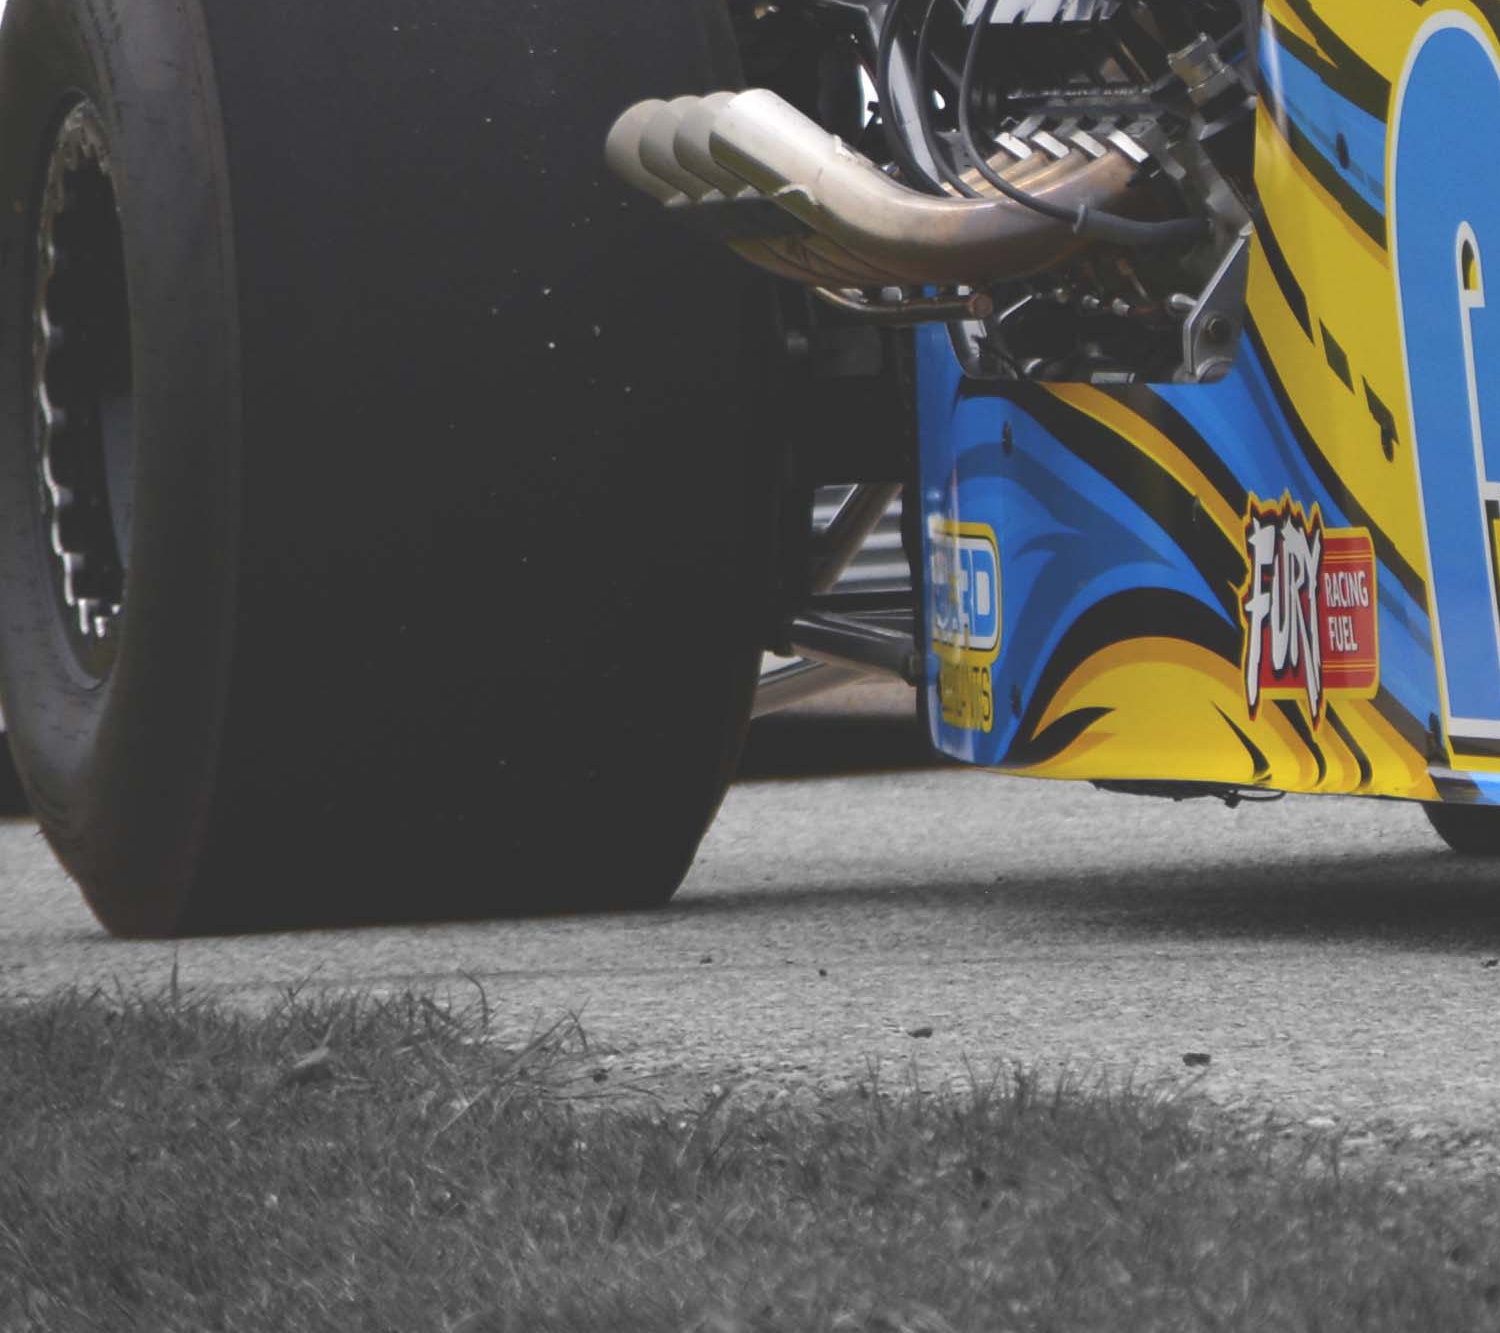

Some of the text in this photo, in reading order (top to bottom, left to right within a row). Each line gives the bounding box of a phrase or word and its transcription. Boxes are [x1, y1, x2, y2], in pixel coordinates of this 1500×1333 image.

[1323, 569, 1370, 609] RACING
[1244, 515, 1322, 708] FURY
[1326, 615, 1359, 653] FUEL
